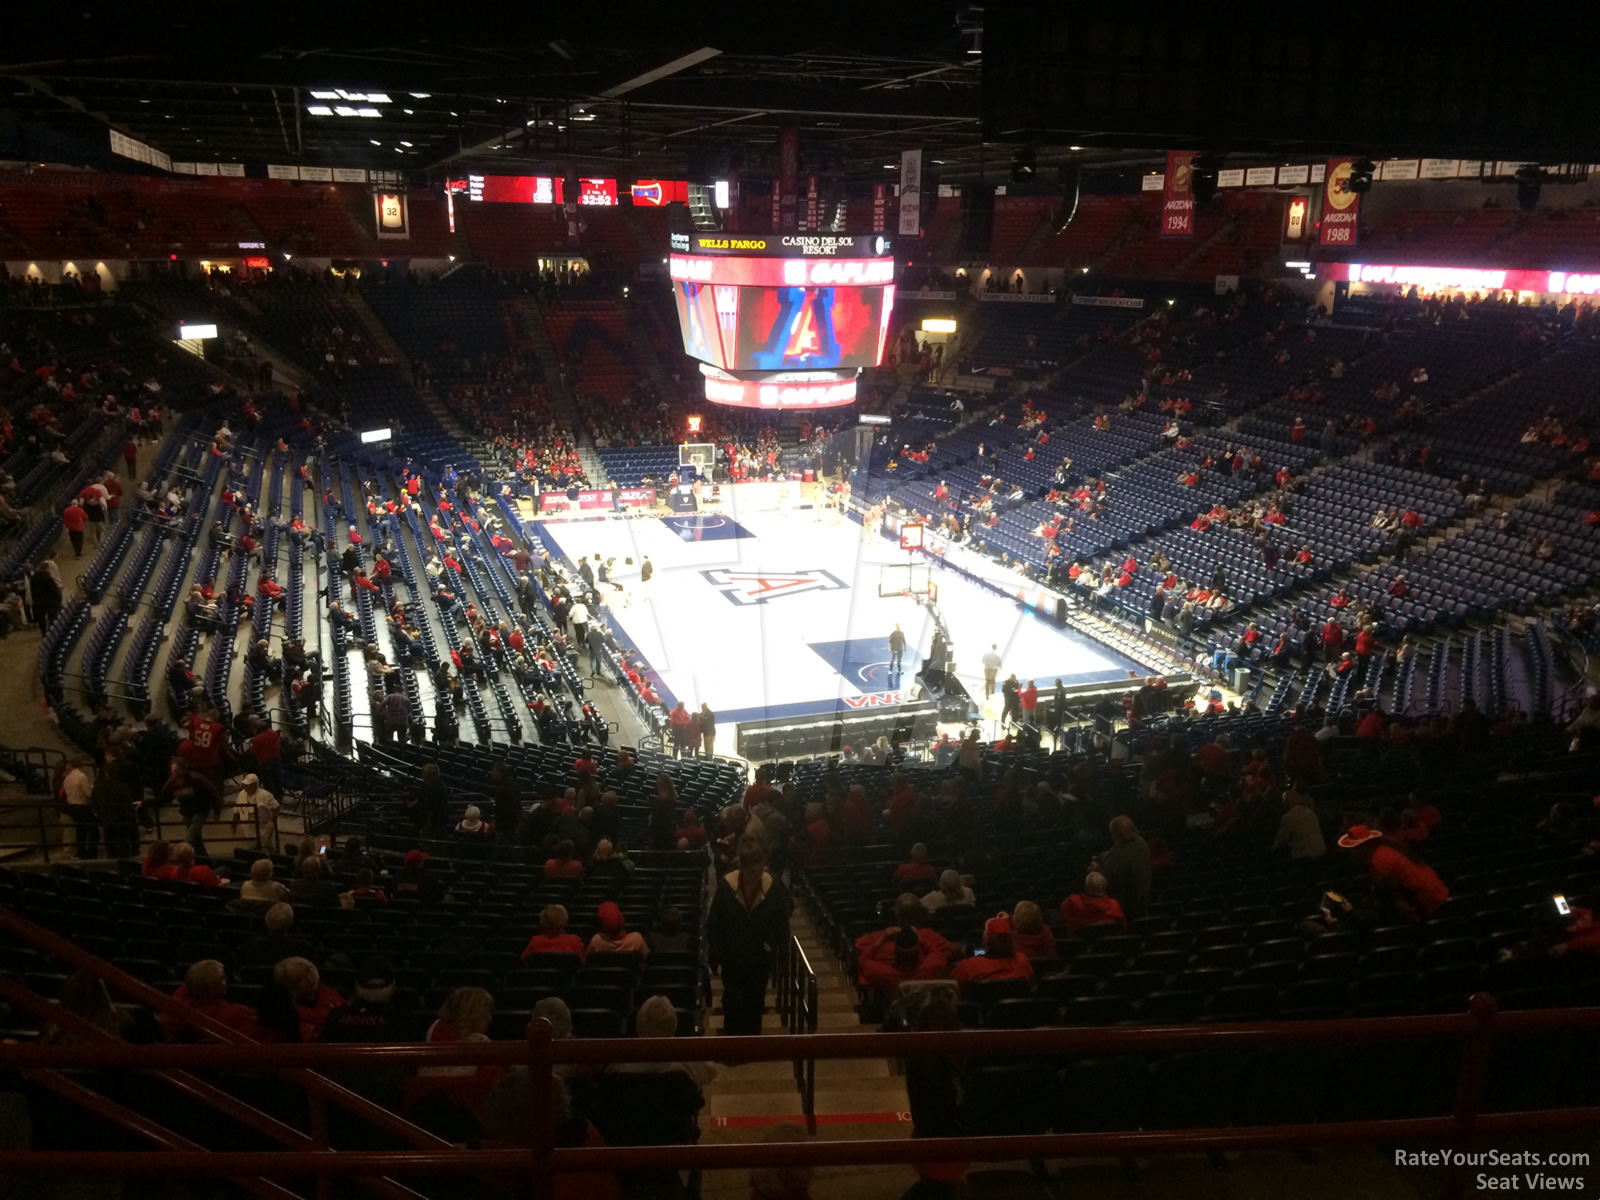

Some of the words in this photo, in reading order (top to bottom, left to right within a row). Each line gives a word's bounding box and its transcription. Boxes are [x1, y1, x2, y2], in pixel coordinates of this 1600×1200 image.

[582, 194, 612, 206] 32:52
[1164, 200, 1192, 210] ARIZONA
[386, 208, 397, 216] 32
[1168, 216, 1188, 230] 1994
[1291, 216, 1300, 226] 00
[1324, 213, 1356, 223] ARIZONA
[903, 218, 916, 230] 1997
[1326, 228, 1350, 241] 1988
[698, 239, 728, 248] WELLS
[730, 240, 766, 250] FARGO
[782, 236, 820, 246] CASINO
[820, 236, 838, 246] DEL
[838, 237, 854, 246] SOL
[802, 246, 837, 255] RESORT
[194, 730, 212, 748] 58
[715, 1116, 728, 1126] 11
[896, 1112, 912, 1122] 10
